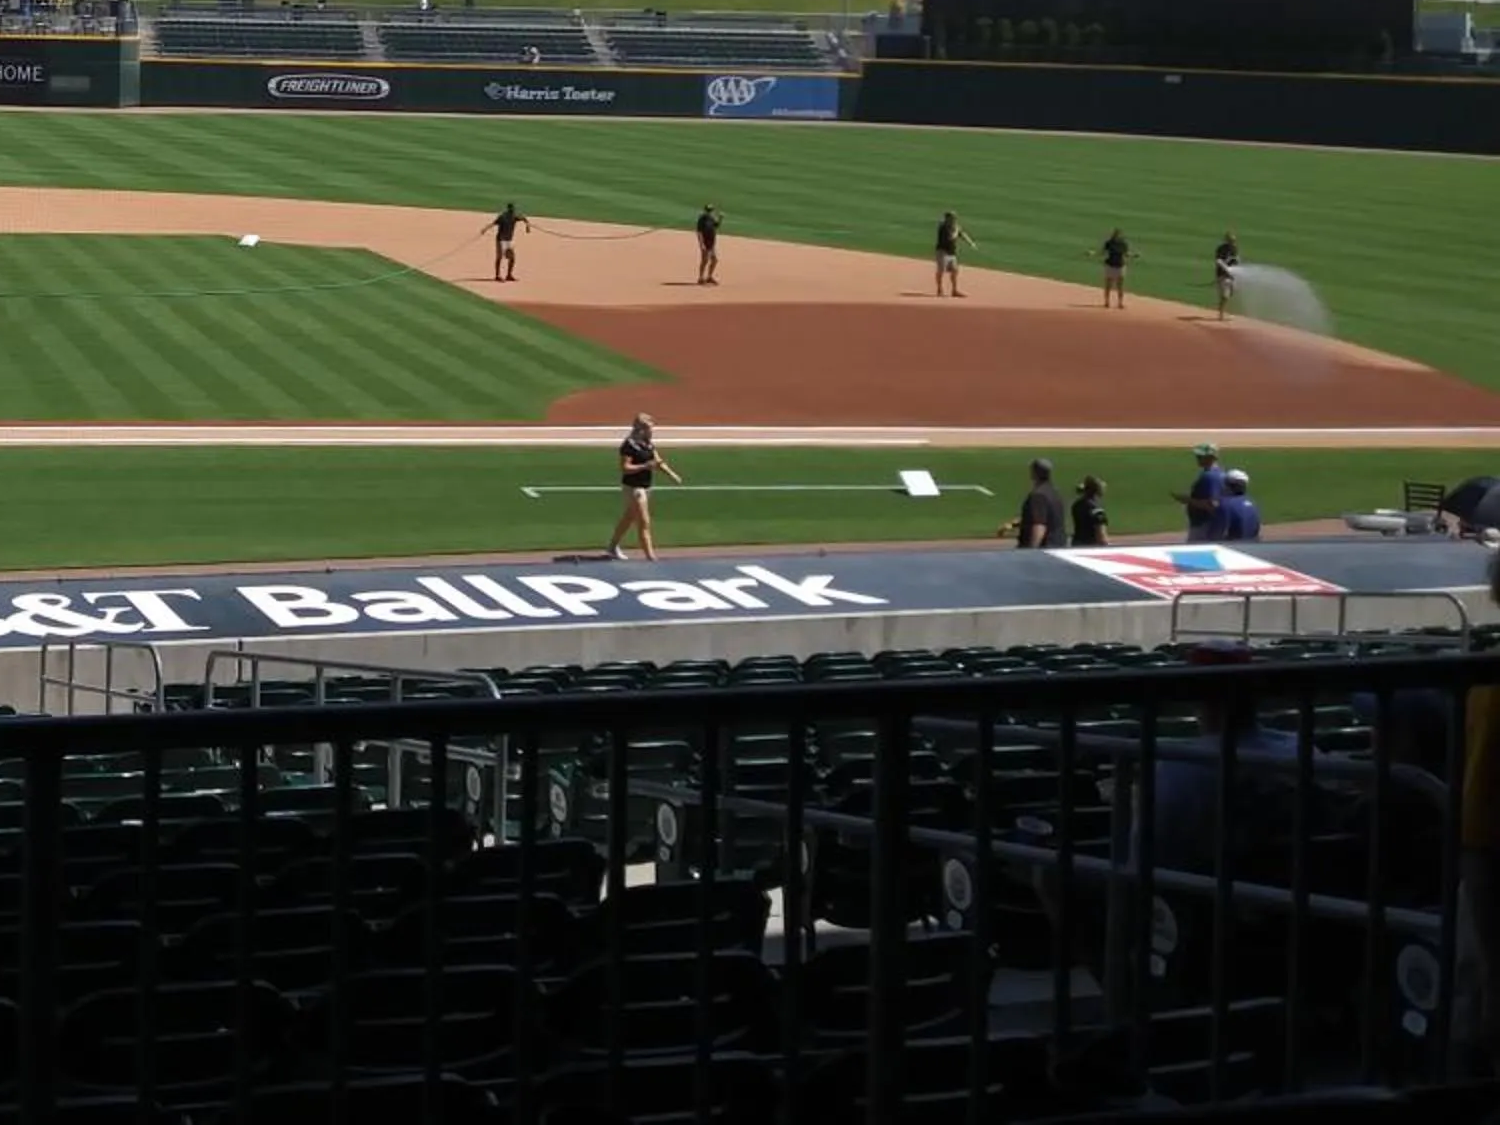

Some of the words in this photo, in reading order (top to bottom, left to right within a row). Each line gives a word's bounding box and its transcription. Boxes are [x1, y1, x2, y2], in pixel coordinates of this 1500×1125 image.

[279, 78, 379, 94] FREIGHTLINER
[506, 86, 559, 100] Harris
[711, 77, 749, 103] AAA
[237, 565, 889, 628] BallPark
